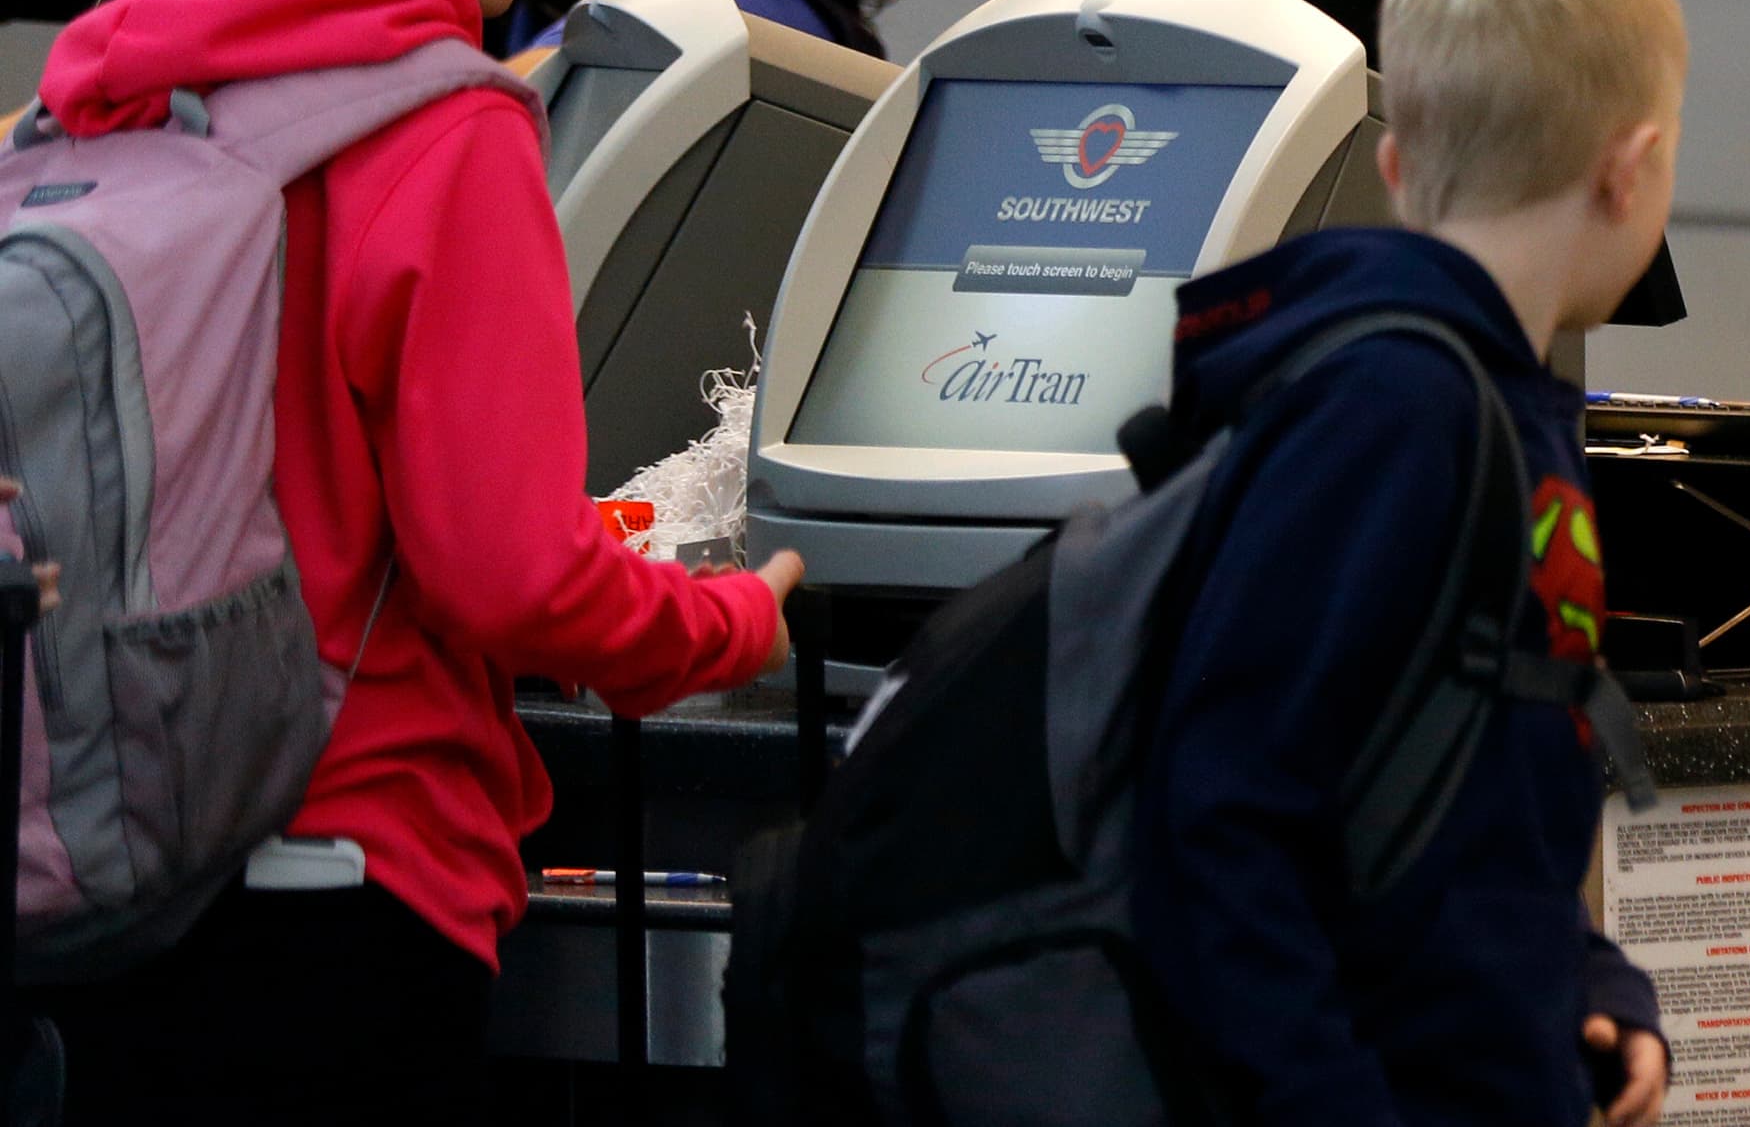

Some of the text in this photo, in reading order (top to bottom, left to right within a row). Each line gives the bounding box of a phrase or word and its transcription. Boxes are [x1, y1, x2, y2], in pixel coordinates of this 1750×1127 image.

[997, 196, 1151, 223] SOUTHWEST
[965, 261, 1133, 282] Please touch screen to begin
[939, 357, 1086, 405] airTran
[1721, 1091, 1728, 1099] OF
